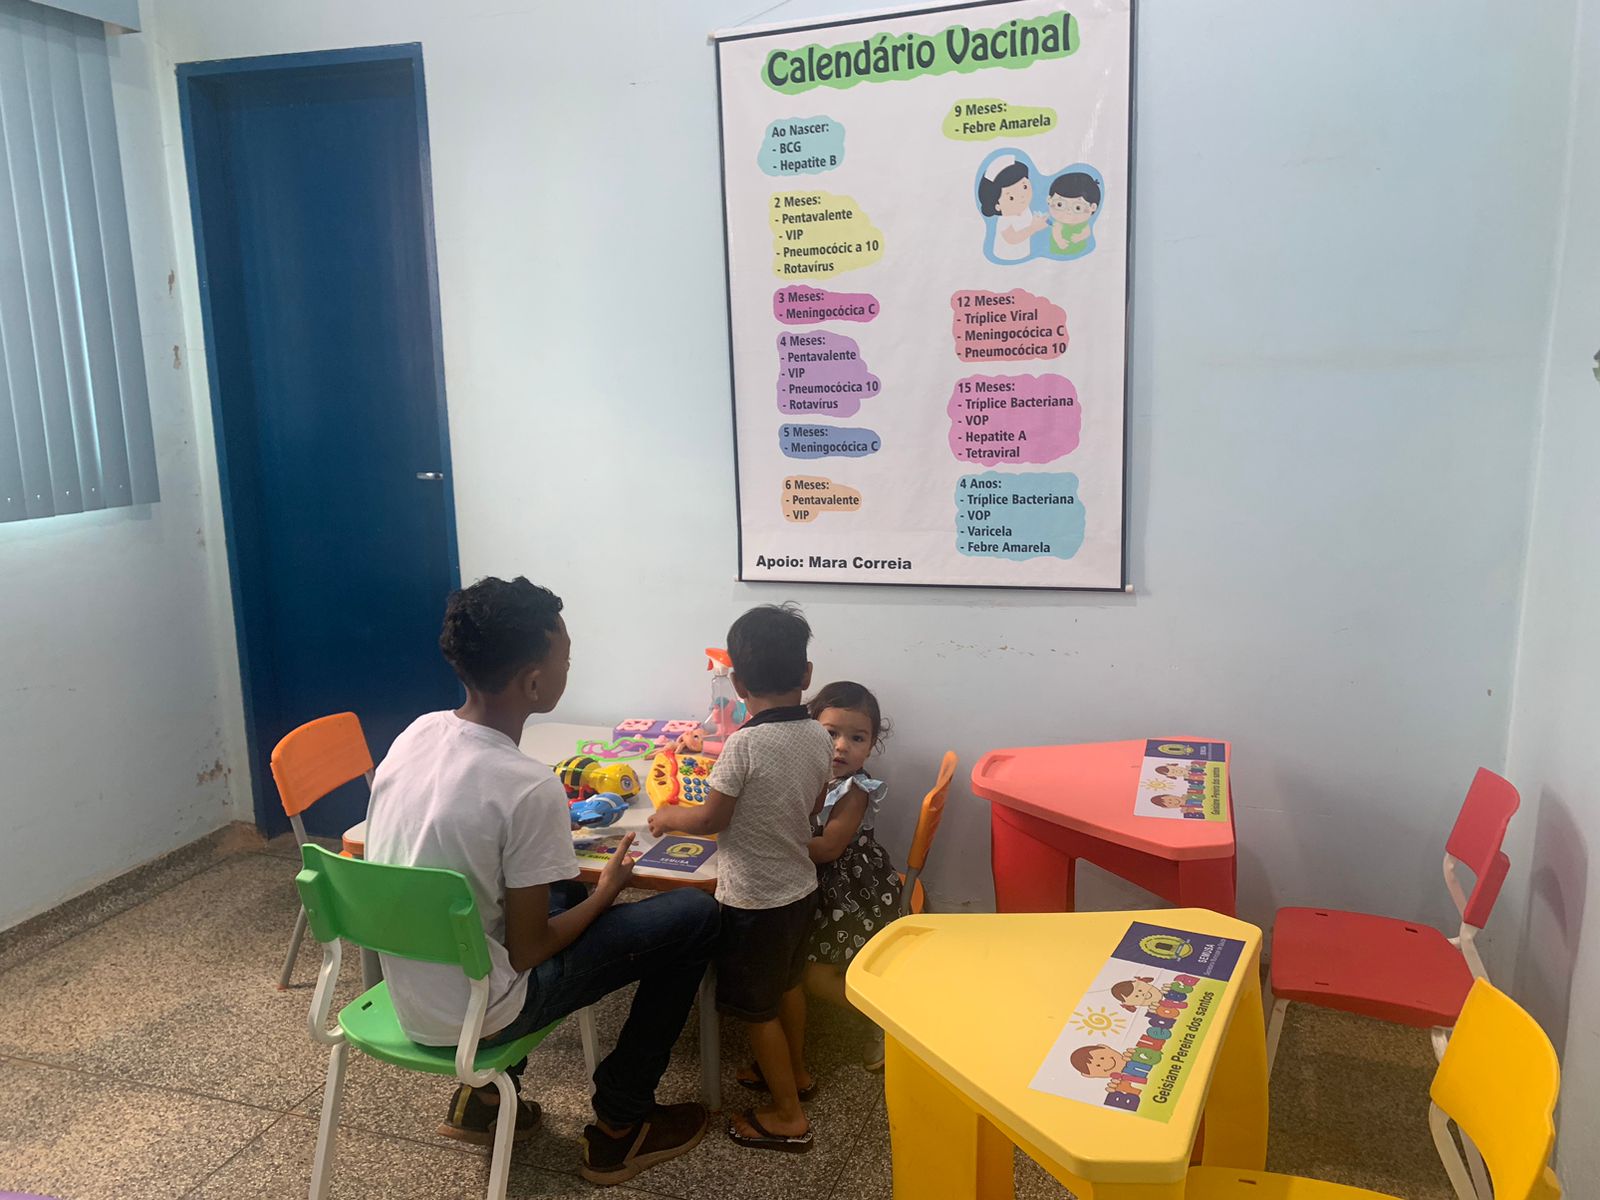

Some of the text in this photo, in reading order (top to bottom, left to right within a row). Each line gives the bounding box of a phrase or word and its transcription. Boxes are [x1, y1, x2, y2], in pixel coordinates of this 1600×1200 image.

[767, 13, 1071, 86] Calendário Vacinal
[954, 103, 1007, 117] 9 Meses:
[771, 123, 829, 138] Ao Nascer:
[963, 121, 996, 134] Febre
[1000, 114, 1051, 130] Amarela
[780, 141, 801, 154] BCG
[780, 156, 826, 172] Hepatite
[830, 155, 837, 166] B
[774, 196, 821, 208] 2 Meses:
[782, 209, 853, 224] Pentavalente
[786, 229, 804, 240] VIP
[783, 242, 853, 257] Pneumocócic
[855, 243, 862, 252] a
[866, 240, 879, 252] 10
[784, 261, 834, 274] Rotavírus
[778, 292, 825, 303] 3 Meses:
[957, 295, 1015, 307] 12 Meses:
[786, 304, 865, 320] Meningocócica
[868, 304, 875, 315] C
[965, 311, 1007, 326] Tríplice
[1010, 308, 1038, 322] Viral
[965, 326, 1052, 342] Meningocócica
[1056, 325, 1065, 337] C
[780, 336, 826, 346] 4 Meses:
[788, 350, 856, 362] Pentavalente
[965, 344, 1048, 358] Pneumocócica
[1052, 342, 1066, 354] 10
[788, 367, 805, 378] VIP
[789, 381, 863, 394] Pneumocócica
[865, 381, 879, 392] 10
[958, 382, 1015, 393] 15 Meses:
[789, 398, 838, 410] Rotavírus
[965, 397, 1007, 412] Tríplice
[1011, 395, 1073, 408] Bacteriana
[965, 415, 989, 426] VOP
[783, 427, 828, 437] 5 Meses:
[965, 430, 1015, 444] Hepatite
[1018, 430, 1027, 441] A
[791, 441, 867, 454] Meningocócica
[871, 441, 879, 451] C
[965, 446, 1020, 458] Tetraviral
[785, 480, 829, 490] 6 Meses:
[960, 478, 1002, 489] 4 Anos:
[793, 494, 859, 505] Pentavalente
[967, 494, 1009, 507] Tríplice
[1012, 493, 1074, 504] Bacteriana
[793, 510, 809, 520] VIP
[967, 510, 991, 521] VOP
[967, 525, 1012, 537] Varicela
[968, 541, 999, 552] Febre
[1002, 542, 1051, 553] Amarela
[756, 555, 912, 570] Apoio: Mara Correia
[1197, 944, 1216, 963] SEMUSA
[1104, 973, 1200, 1112] Brinquedoteca
[1152, 991, 1215, 1104] Geisiane Pereira dos santos
